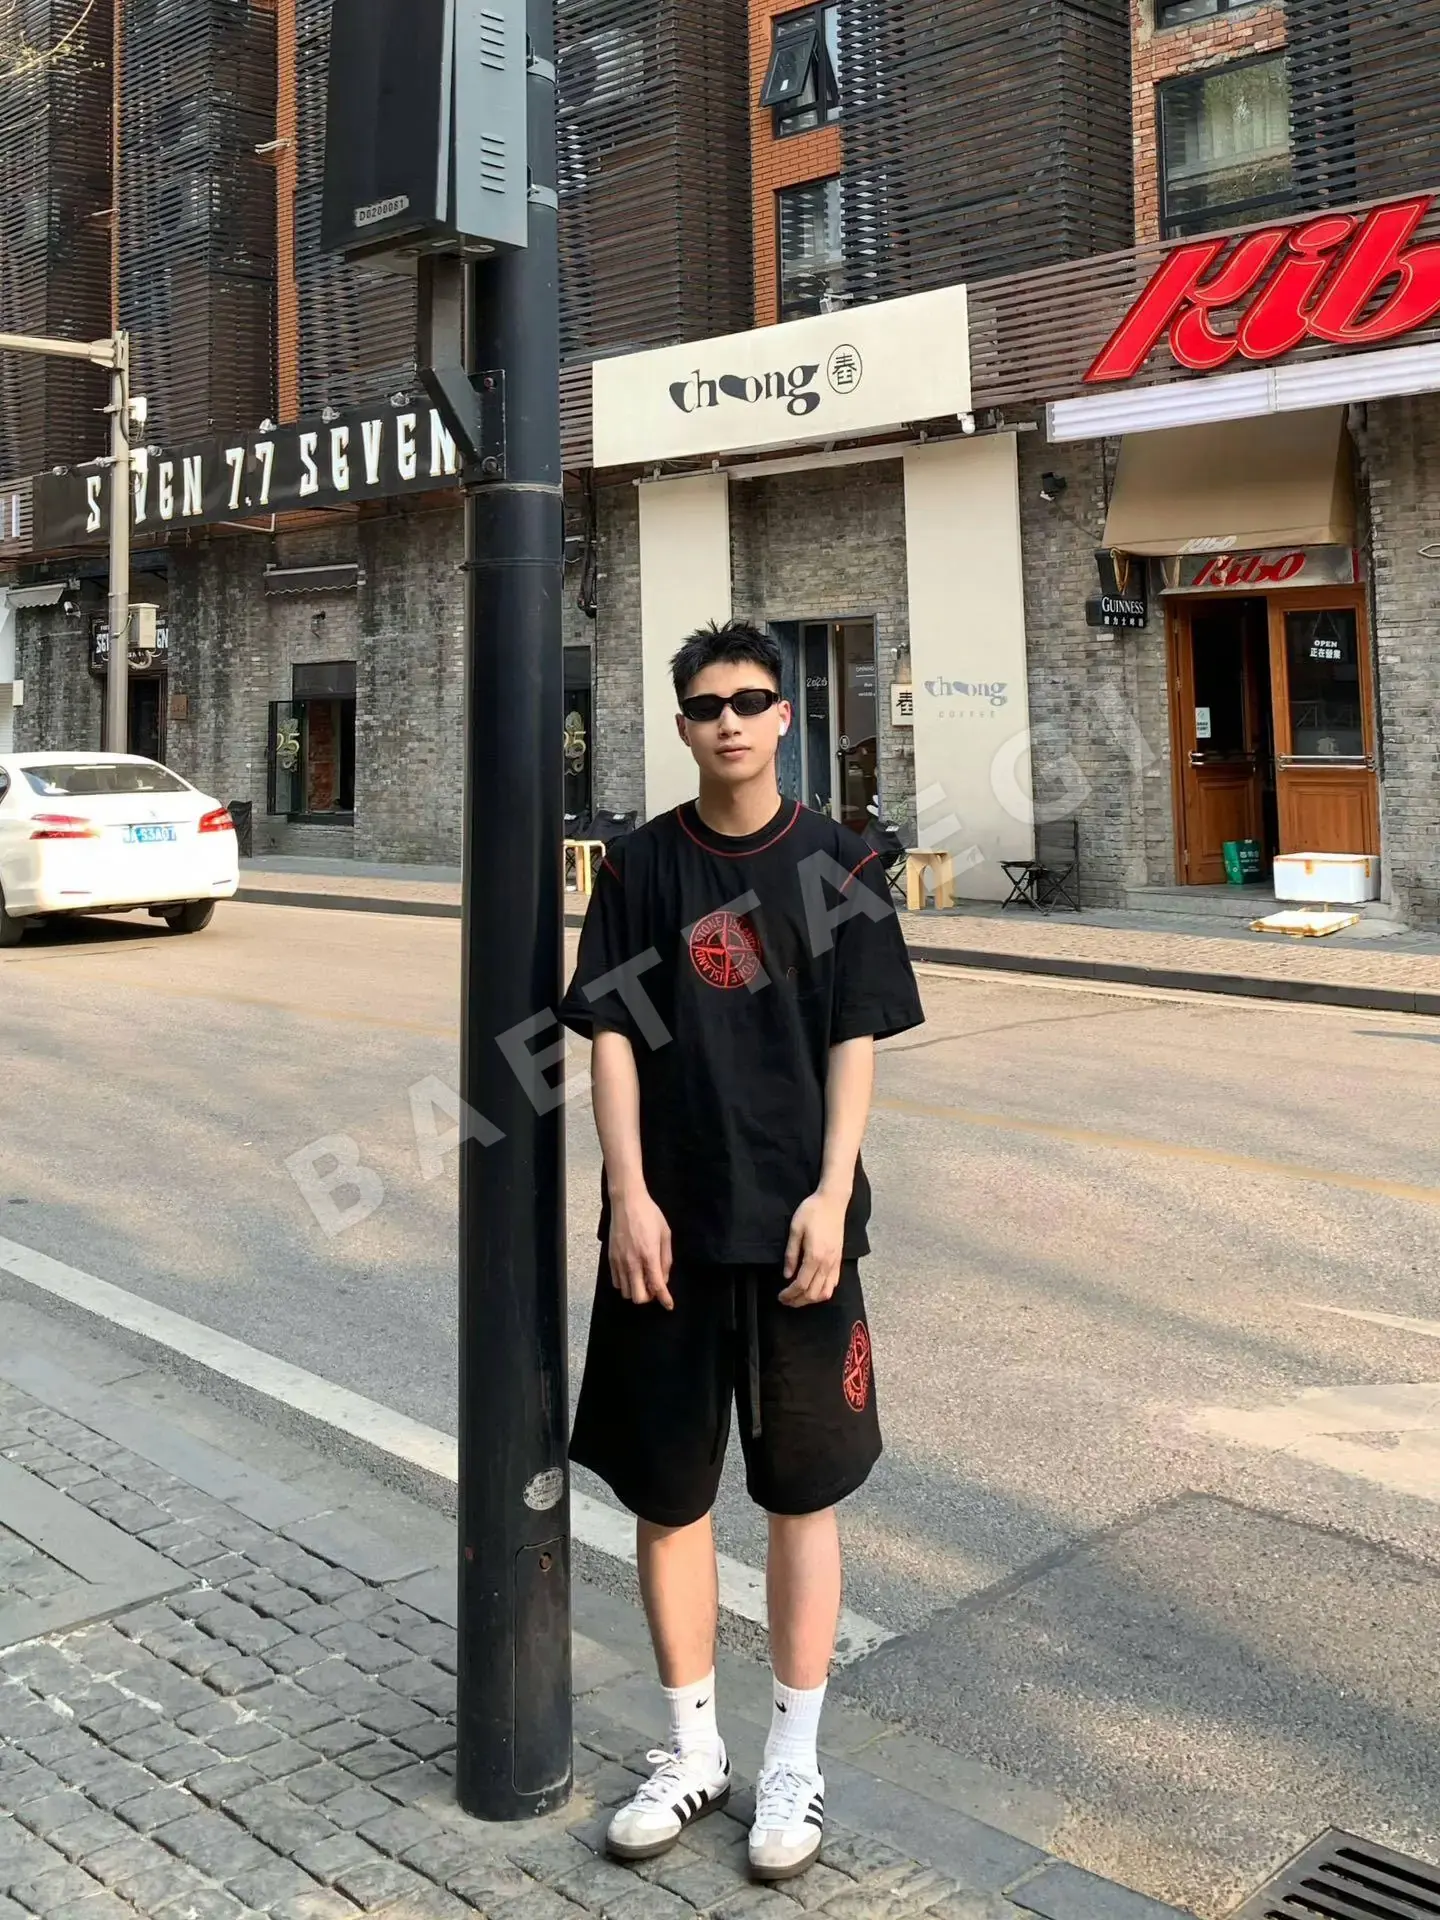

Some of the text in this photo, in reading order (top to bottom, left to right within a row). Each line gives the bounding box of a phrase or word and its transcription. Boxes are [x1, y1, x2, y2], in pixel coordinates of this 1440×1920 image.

[86, 454, 203, 533] SVEN
[299, 408, 457, 497] SEVEN
[1101, 596, 1145, 614] GUINNESS
[1314, 640, 1338, 648] OPEN
[695, 915, 724, 945] STONE
[694, 950, 725, 982] ISLAND
